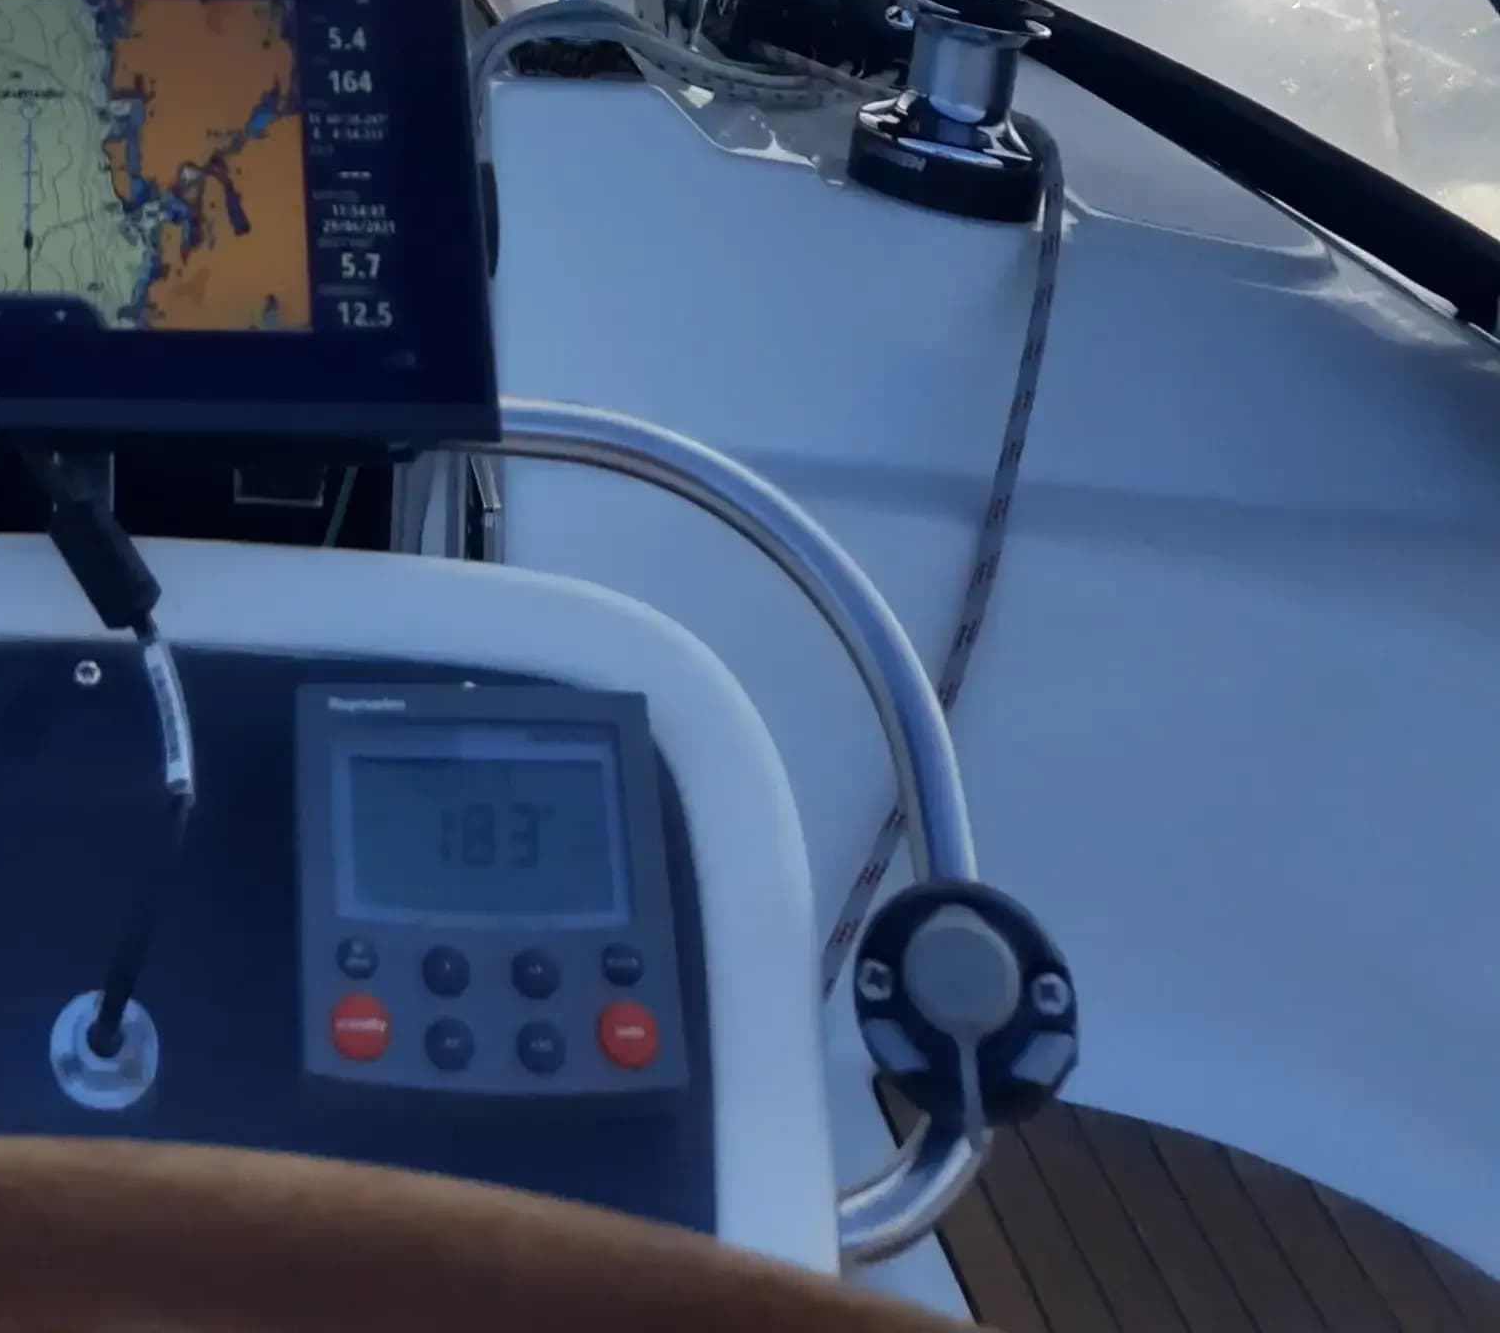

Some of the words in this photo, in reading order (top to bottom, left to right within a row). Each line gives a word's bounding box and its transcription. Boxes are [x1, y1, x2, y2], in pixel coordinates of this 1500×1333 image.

[327, 25, 368, 53] 5.4
[327, 69, 374, 94] 164
[339, 251, 382, 279] 5.7
[336, 300, 394, 328] 12.5
